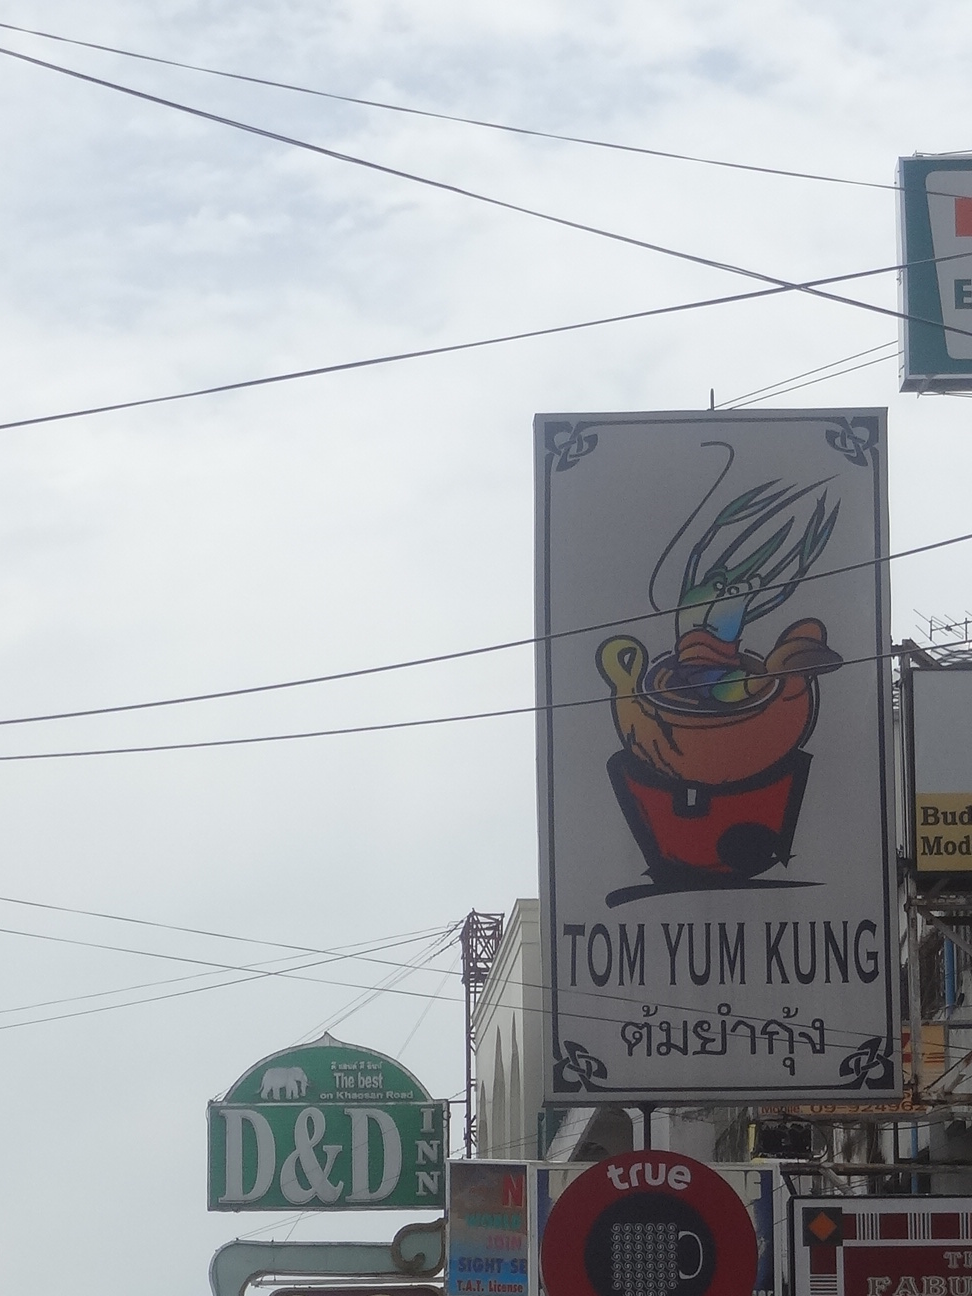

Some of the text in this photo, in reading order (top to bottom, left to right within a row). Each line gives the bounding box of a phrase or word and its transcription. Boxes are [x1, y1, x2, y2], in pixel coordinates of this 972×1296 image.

[563, 919, 880, 987] TOM YUM KUNG
[620, 1003, 826, 1076] ต้มยำกุ้ง
[334, 1072, 383, 1089] The best
[386, 1091, 413, 1099] Road
[218, 1106, 402, 1205] D&D
[415, 1108, 441, 1196] INN
[607, 1162, 691, 1190] true
[458, 1256, 504, 1274] SIGHT
[488, 1280, 524, 1294] License
